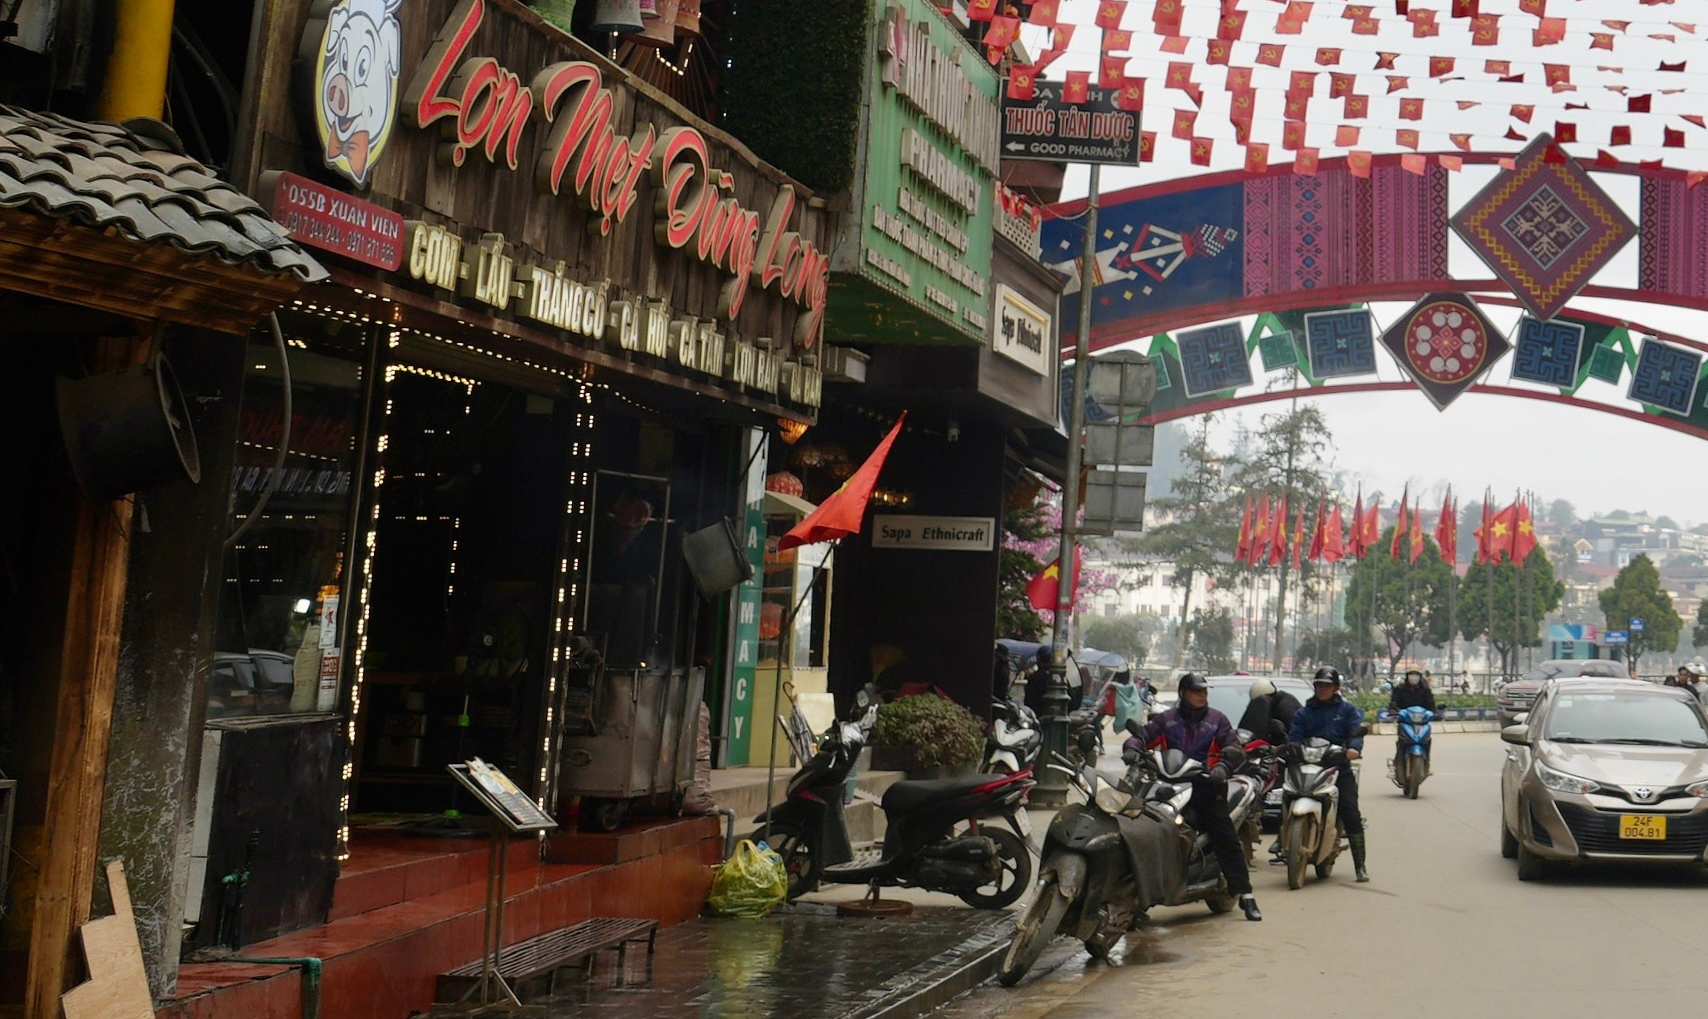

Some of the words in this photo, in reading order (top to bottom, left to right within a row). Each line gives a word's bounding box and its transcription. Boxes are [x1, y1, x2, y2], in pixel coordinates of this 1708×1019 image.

[1006, 99, 1055, 136] THUỐC
[1059, 105, 1091, 139] TÂN
[1091, 110, 1134, 147] DƯỢC
[1030, 142, 1066, 155] GOOD
[410, 224, 462, 292] CƠM
[762, 184, 831, 350] Long
[882, 525, 911, 541] Sapa
[922, 527, 984, 541] Ethnicraft
[1634, 816, 1653, 827] 24F
[1625, 827, 1660, 838] 004.81
